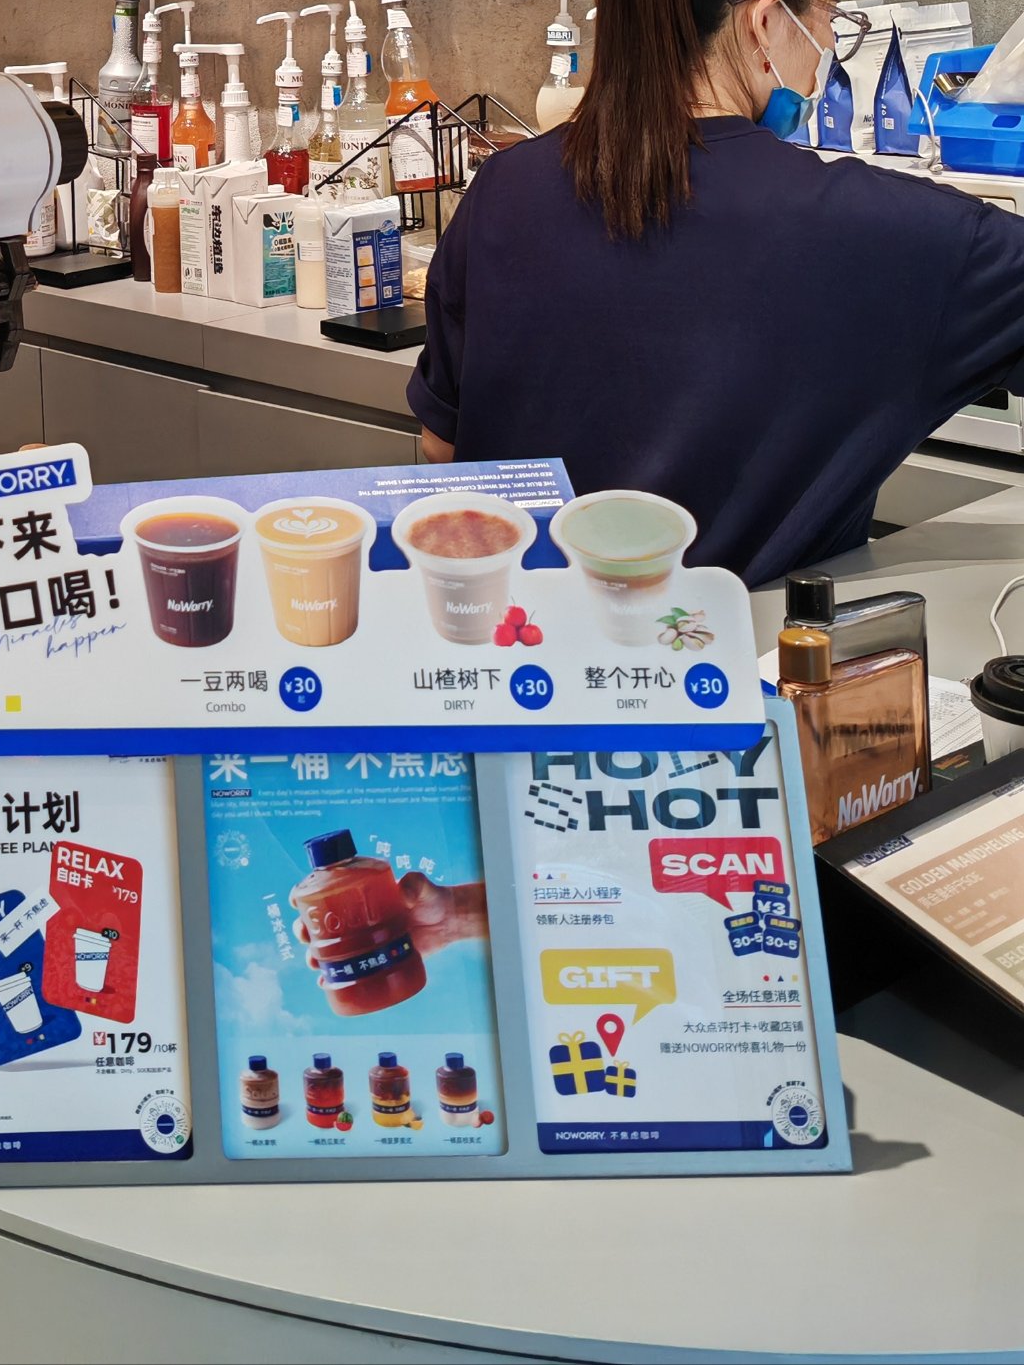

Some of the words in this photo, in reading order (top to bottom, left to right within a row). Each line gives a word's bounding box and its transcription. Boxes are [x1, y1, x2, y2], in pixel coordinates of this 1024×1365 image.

[180, 670, 269, 693] 一豆两喝
[413, 667, 502, 691] 山楂树下
[585, 666, 676, 690] 整个开心
[206, 701, 247, 713] Combo
[444, 699, 475, 711] DIRTY
[616, 698, 648, 709] DIRTY
[524, 782, 779, 833] SHOT
[837, 766, 921, 831] NoWorry
[56, 845, 124, 881] RELAX
[660, 853, 775, 876] SCAN
[898, 864, 953, 894] GOLDEN
[946, 826, 1024, 872] MANDHELING
[56, 866, 94, 889] 自由卡
[533, 886, 622, 901] 扫码进入小程序
[536, 914, 615, 926] 领新人注册券包
[732, 932, 763, 948] 30-5
[765, 935, 798, 951] 30-5
[558, 965, 660, 989] GIFT
[722, 990, 801, 1004] 全场任意消费
[682, 1021, 805, 1034] 大众点评打卡+收藏店铺
[96, 1056, 135, 1067] 任意咖啡
